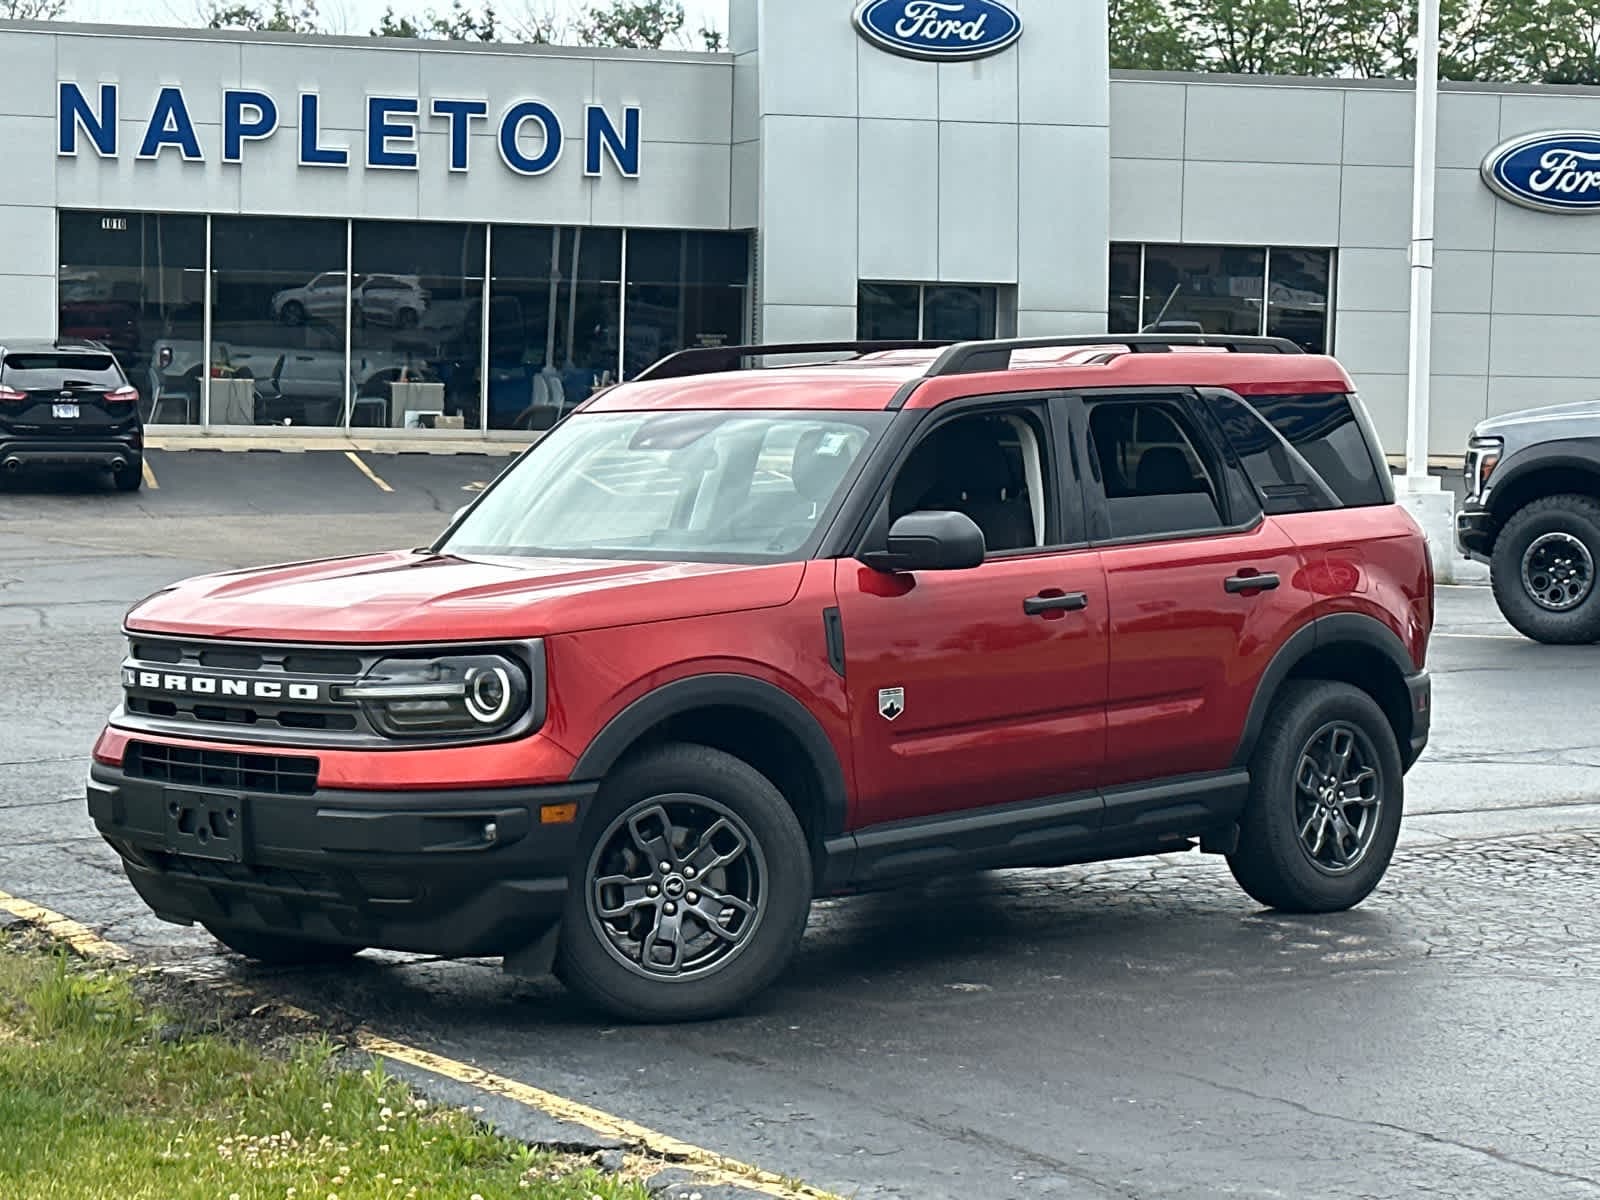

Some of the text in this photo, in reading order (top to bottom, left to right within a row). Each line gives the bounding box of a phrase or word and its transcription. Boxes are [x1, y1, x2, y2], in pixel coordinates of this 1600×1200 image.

[895, 1, 988, 41] Ford
[57, 81, 641, 178] NAPLETON
[1529, 149, 1600, 193] For
[140, 672, 319, 700] BRONCO
